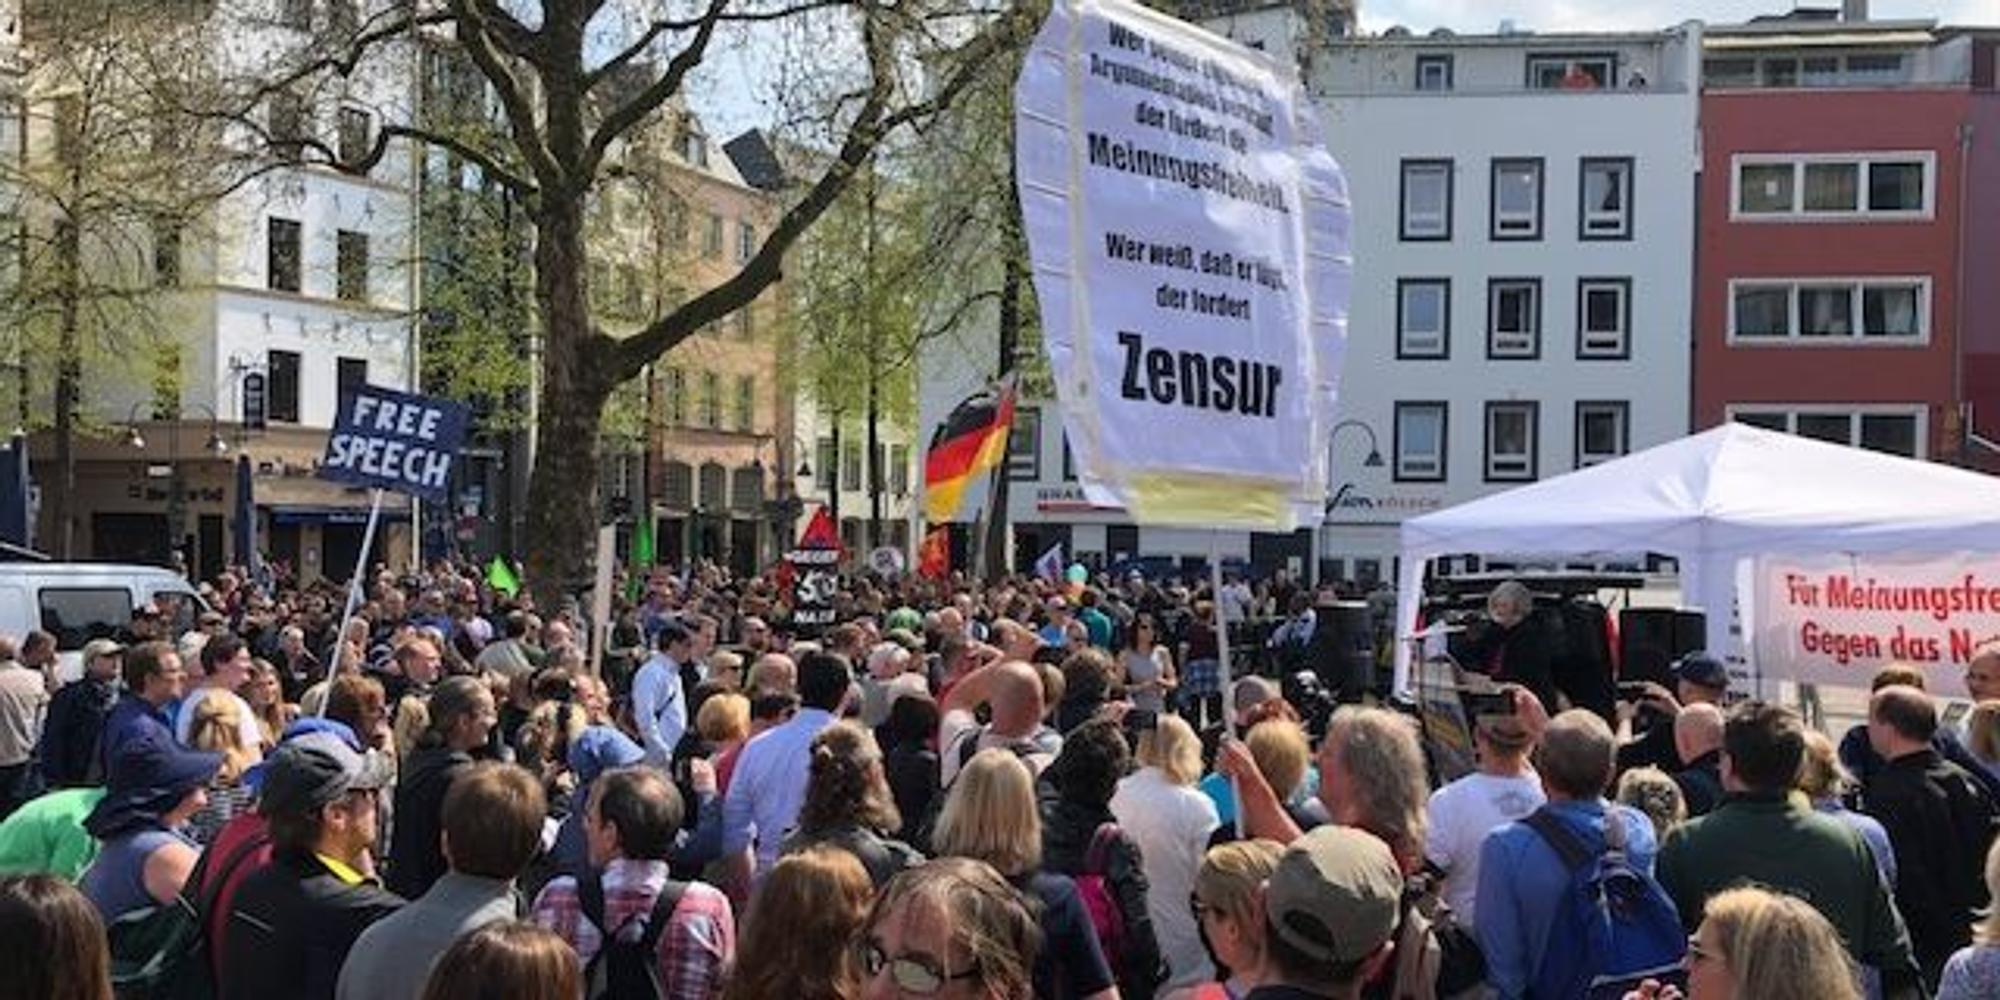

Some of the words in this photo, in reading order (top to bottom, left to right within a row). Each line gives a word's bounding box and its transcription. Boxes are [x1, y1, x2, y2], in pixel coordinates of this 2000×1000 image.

[1109, 22, 1145, 53] Wer
[1135, 101, 1165, 128] der
[1106, 232, 1145, 261] Wer
[1150, 242, 1197, 273] weiß,
[1201, 250, 1233, 279] daß
[1237, 261, 1252, 279] er
[1156, 284, 1187, 310] der
[1192, 289, 1251, 320] fordert
[1117, 331, 1283, 418] Zensur
[353, 395, 442, 441] FREE
[328, 434, 450, 487] SPEECH
[1786, 573, 1820, 605] Für
[1827, 573, 2000, 621] Meinungsfre
[1802, 620, 1881, 666] Gegen
[1890, 625, 1940, 662] das
